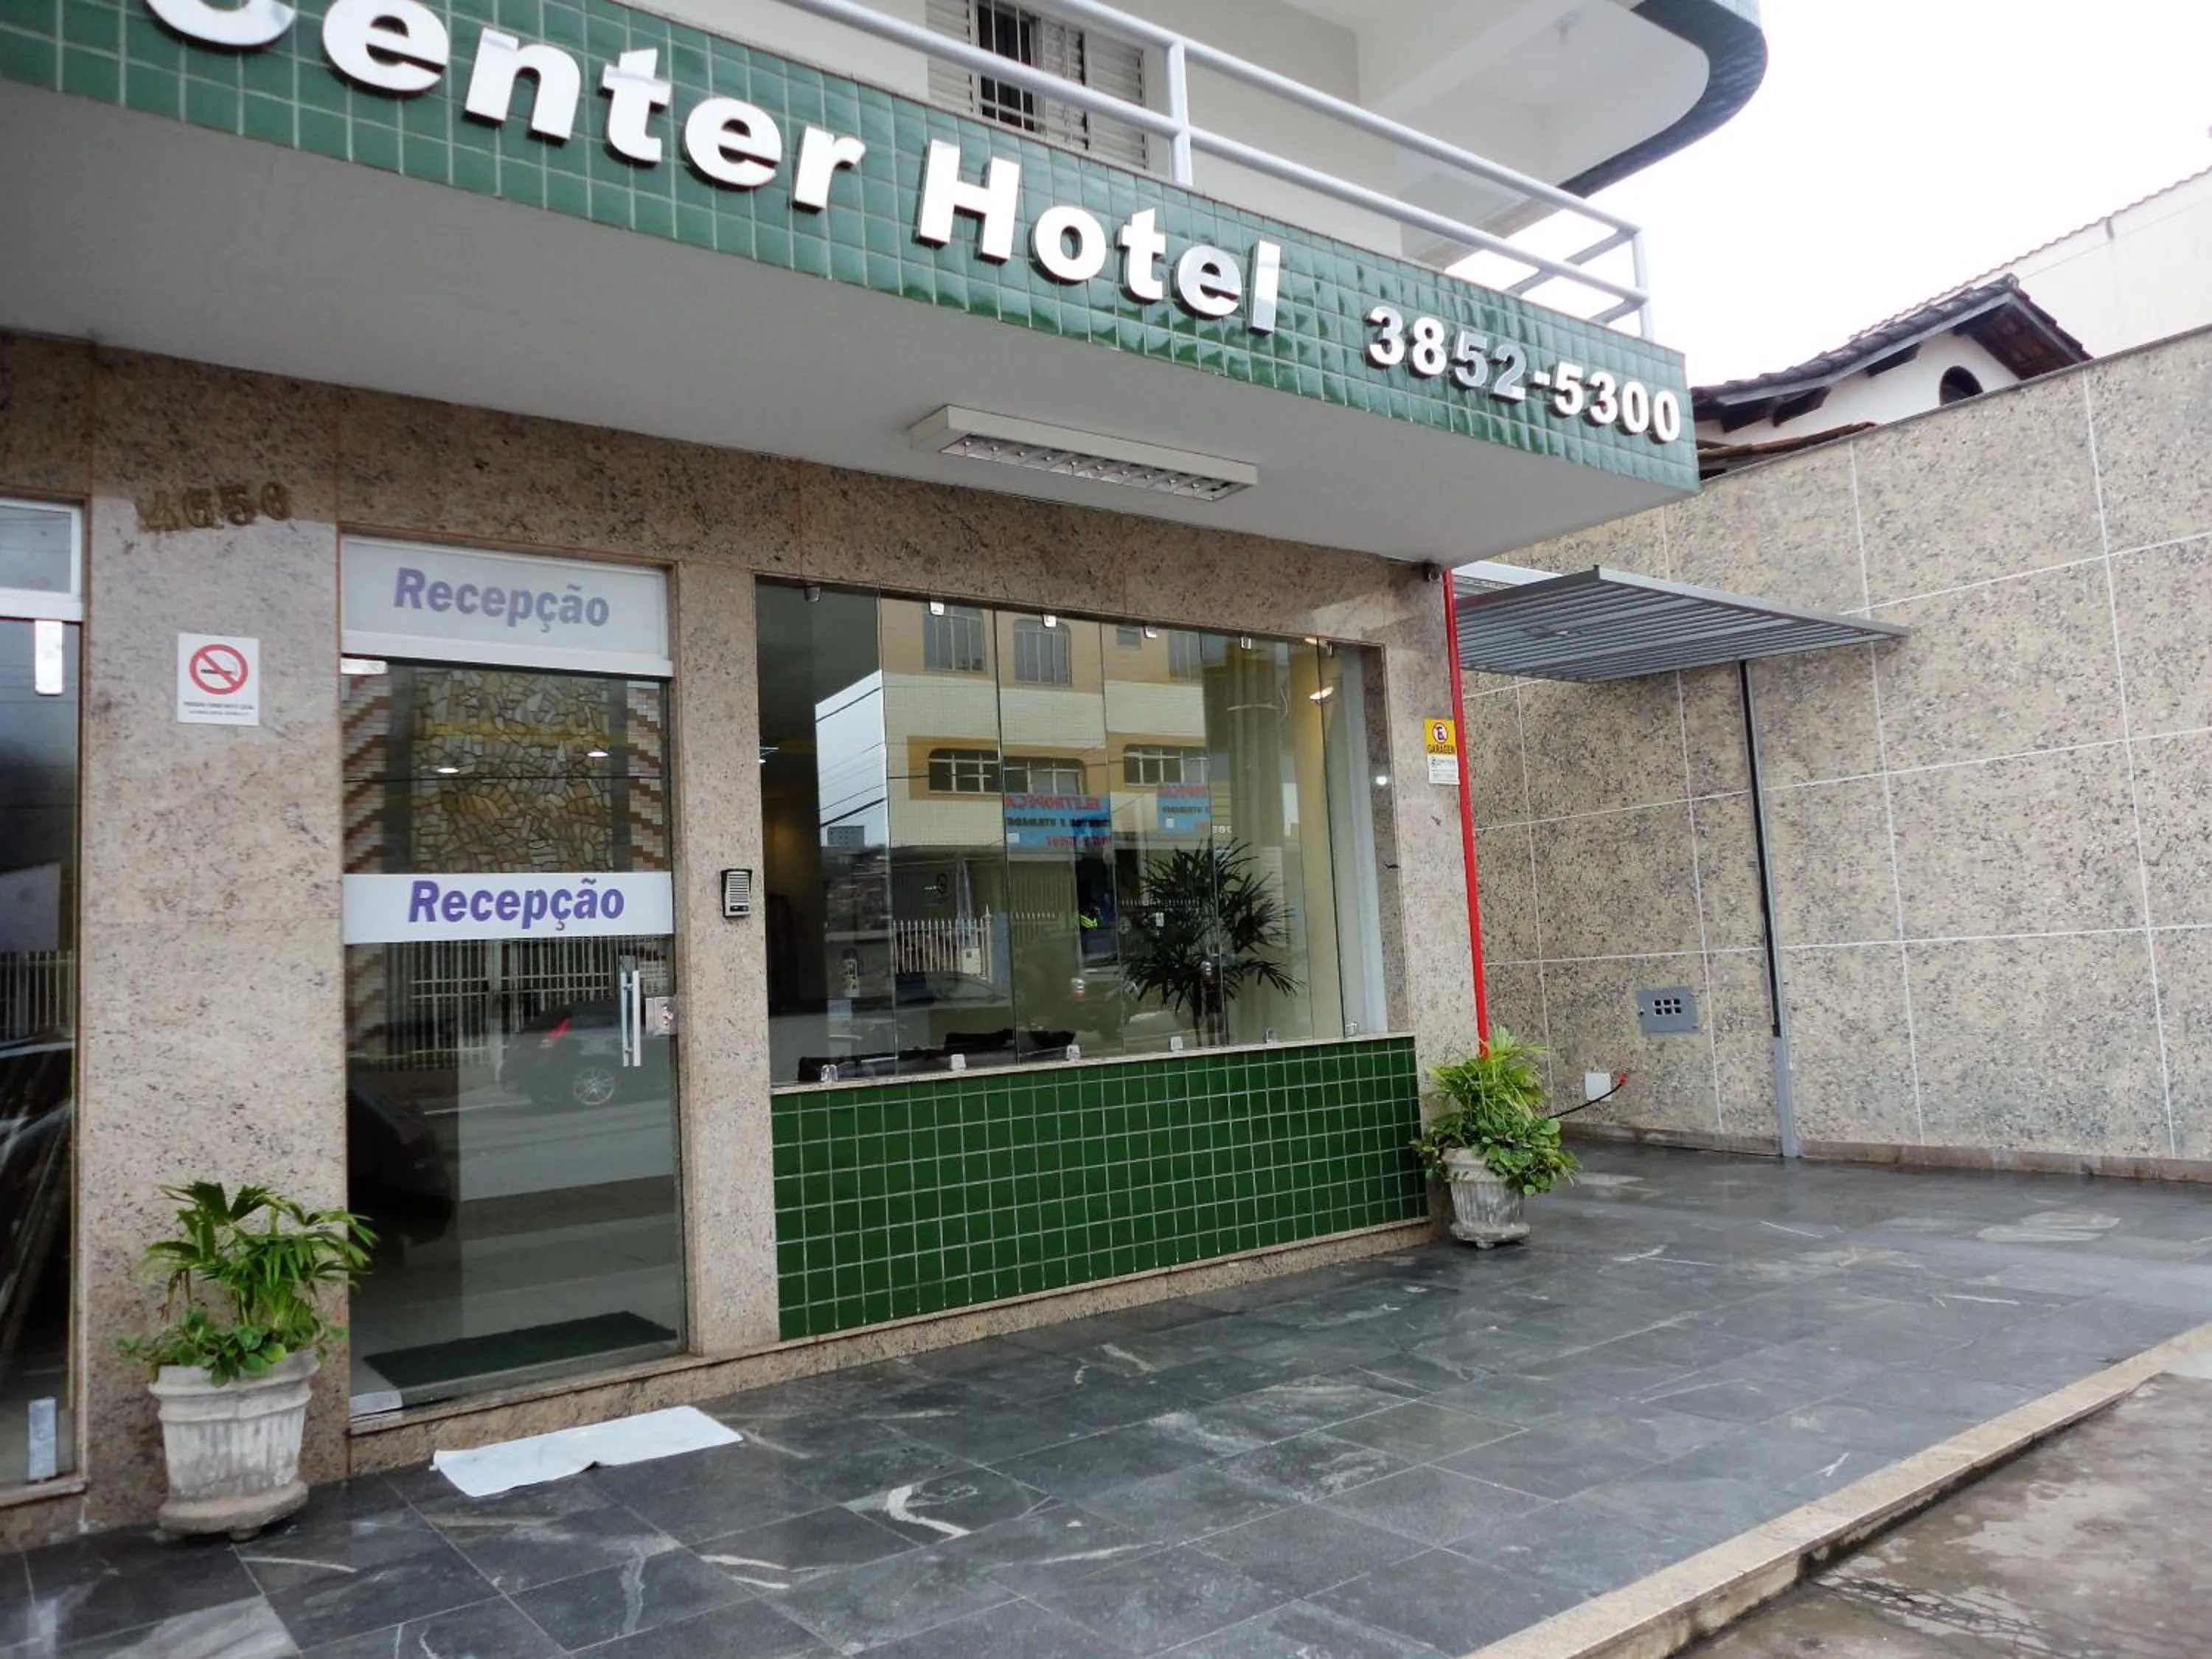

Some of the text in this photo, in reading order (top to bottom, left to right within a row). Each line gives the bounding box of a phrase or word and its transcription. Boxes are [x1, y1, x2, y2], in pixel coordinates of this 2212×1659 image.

[917, 139, 1281, 333] Hotel
[1366, 305, 1680, 442] 3852-5300
[393, 566, 610, 633] Recepção
[408, 877, 625, 931] Recepção
